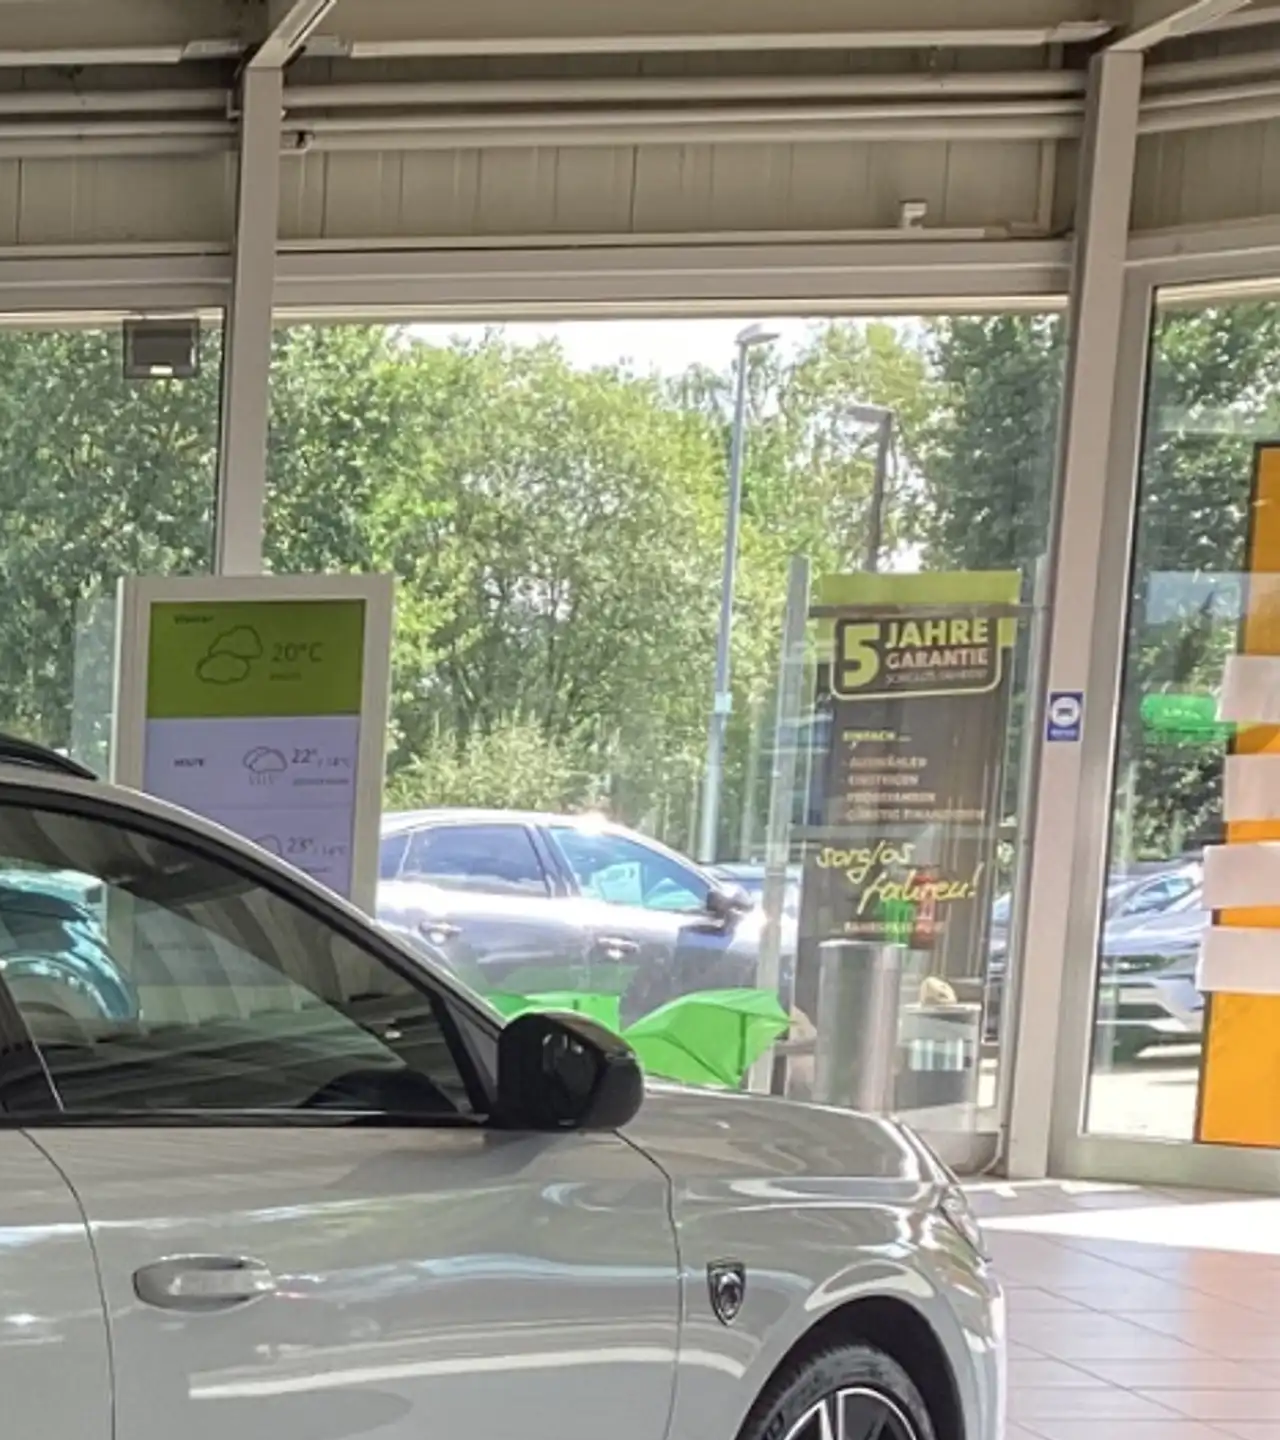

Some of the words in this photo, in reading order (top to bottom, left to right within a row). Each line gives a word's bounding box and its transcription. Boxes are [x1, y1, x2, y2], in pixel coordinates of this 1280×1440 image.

[271, 641, 325, 663] 20°C
[885, 617, 989, 649] JAHRE
[843, 622, 881, 688] 5
[885, 647, 989, 670] GARANTIE
[815, 839, 917, 885] sorglos
[856, 860, 985, 916] fahren!
